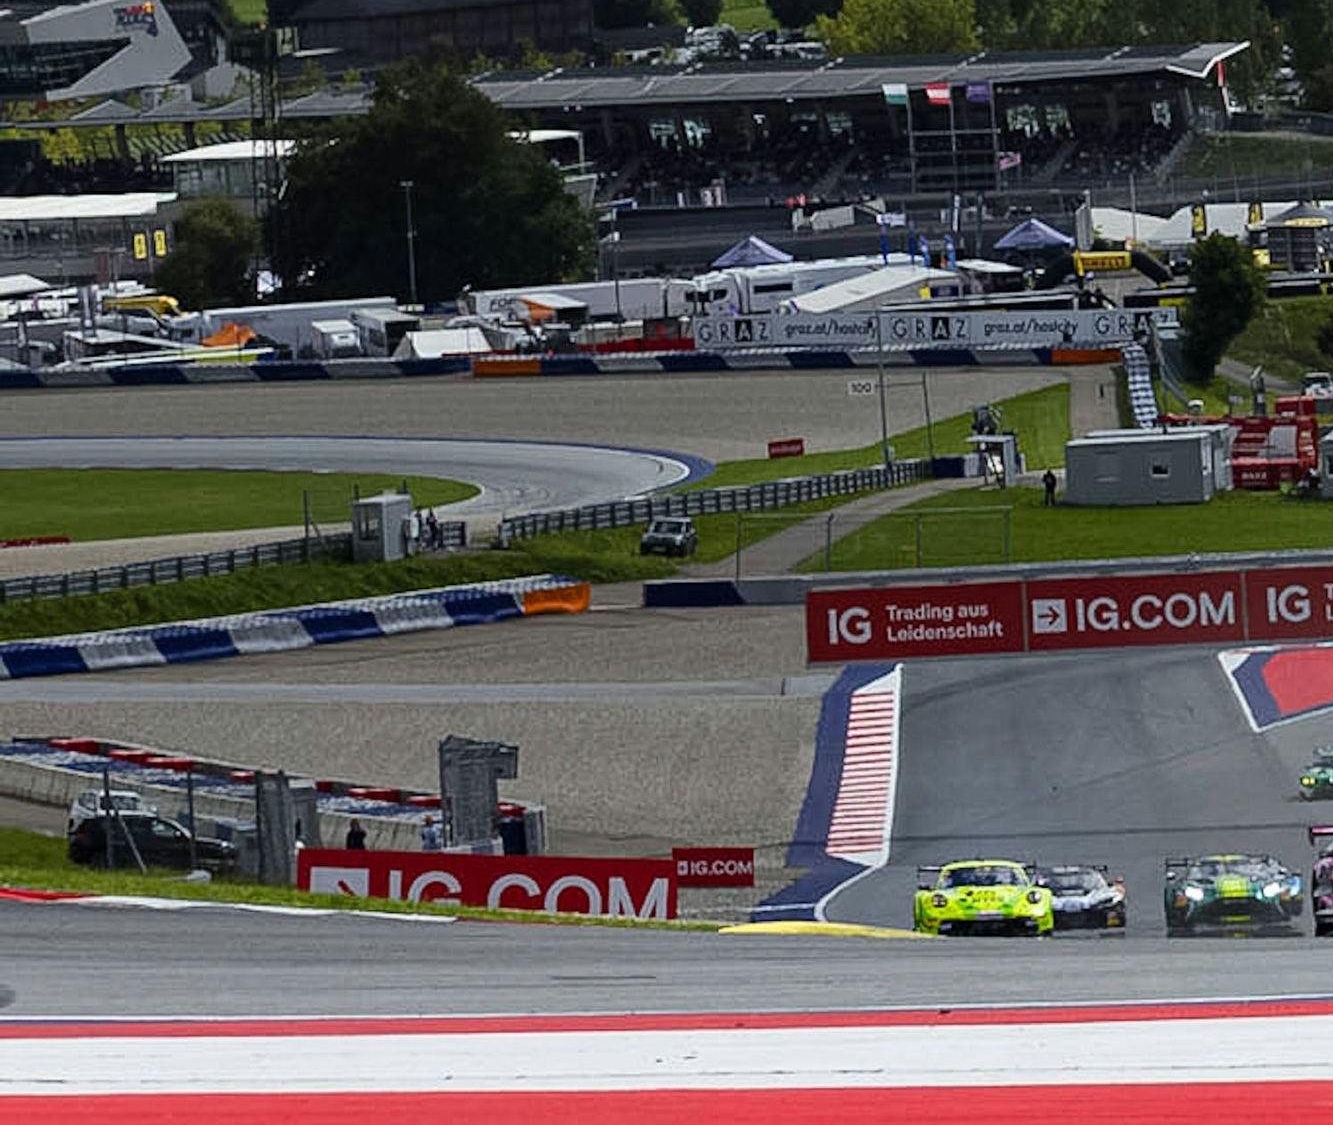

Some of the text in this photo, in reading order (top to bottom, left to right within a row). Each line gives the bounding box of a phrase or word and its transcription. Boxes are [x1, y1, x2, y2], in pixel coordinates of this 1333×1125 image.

[700, 320, 770, 342] GRAZ
[892, 317, 968, 339] GRAZ
[851, 383, 872, 394] 100
[885, 603, 989, 623] Trading aus
[1076, 591, 1236, 632] IG.COM
[1267, 585, 1311, 623] IG
[828, 606, 872, 645] IG
[886, 620, 1004, 642] Leidenschaft
[690, 860, 755, 876] IG.COM
